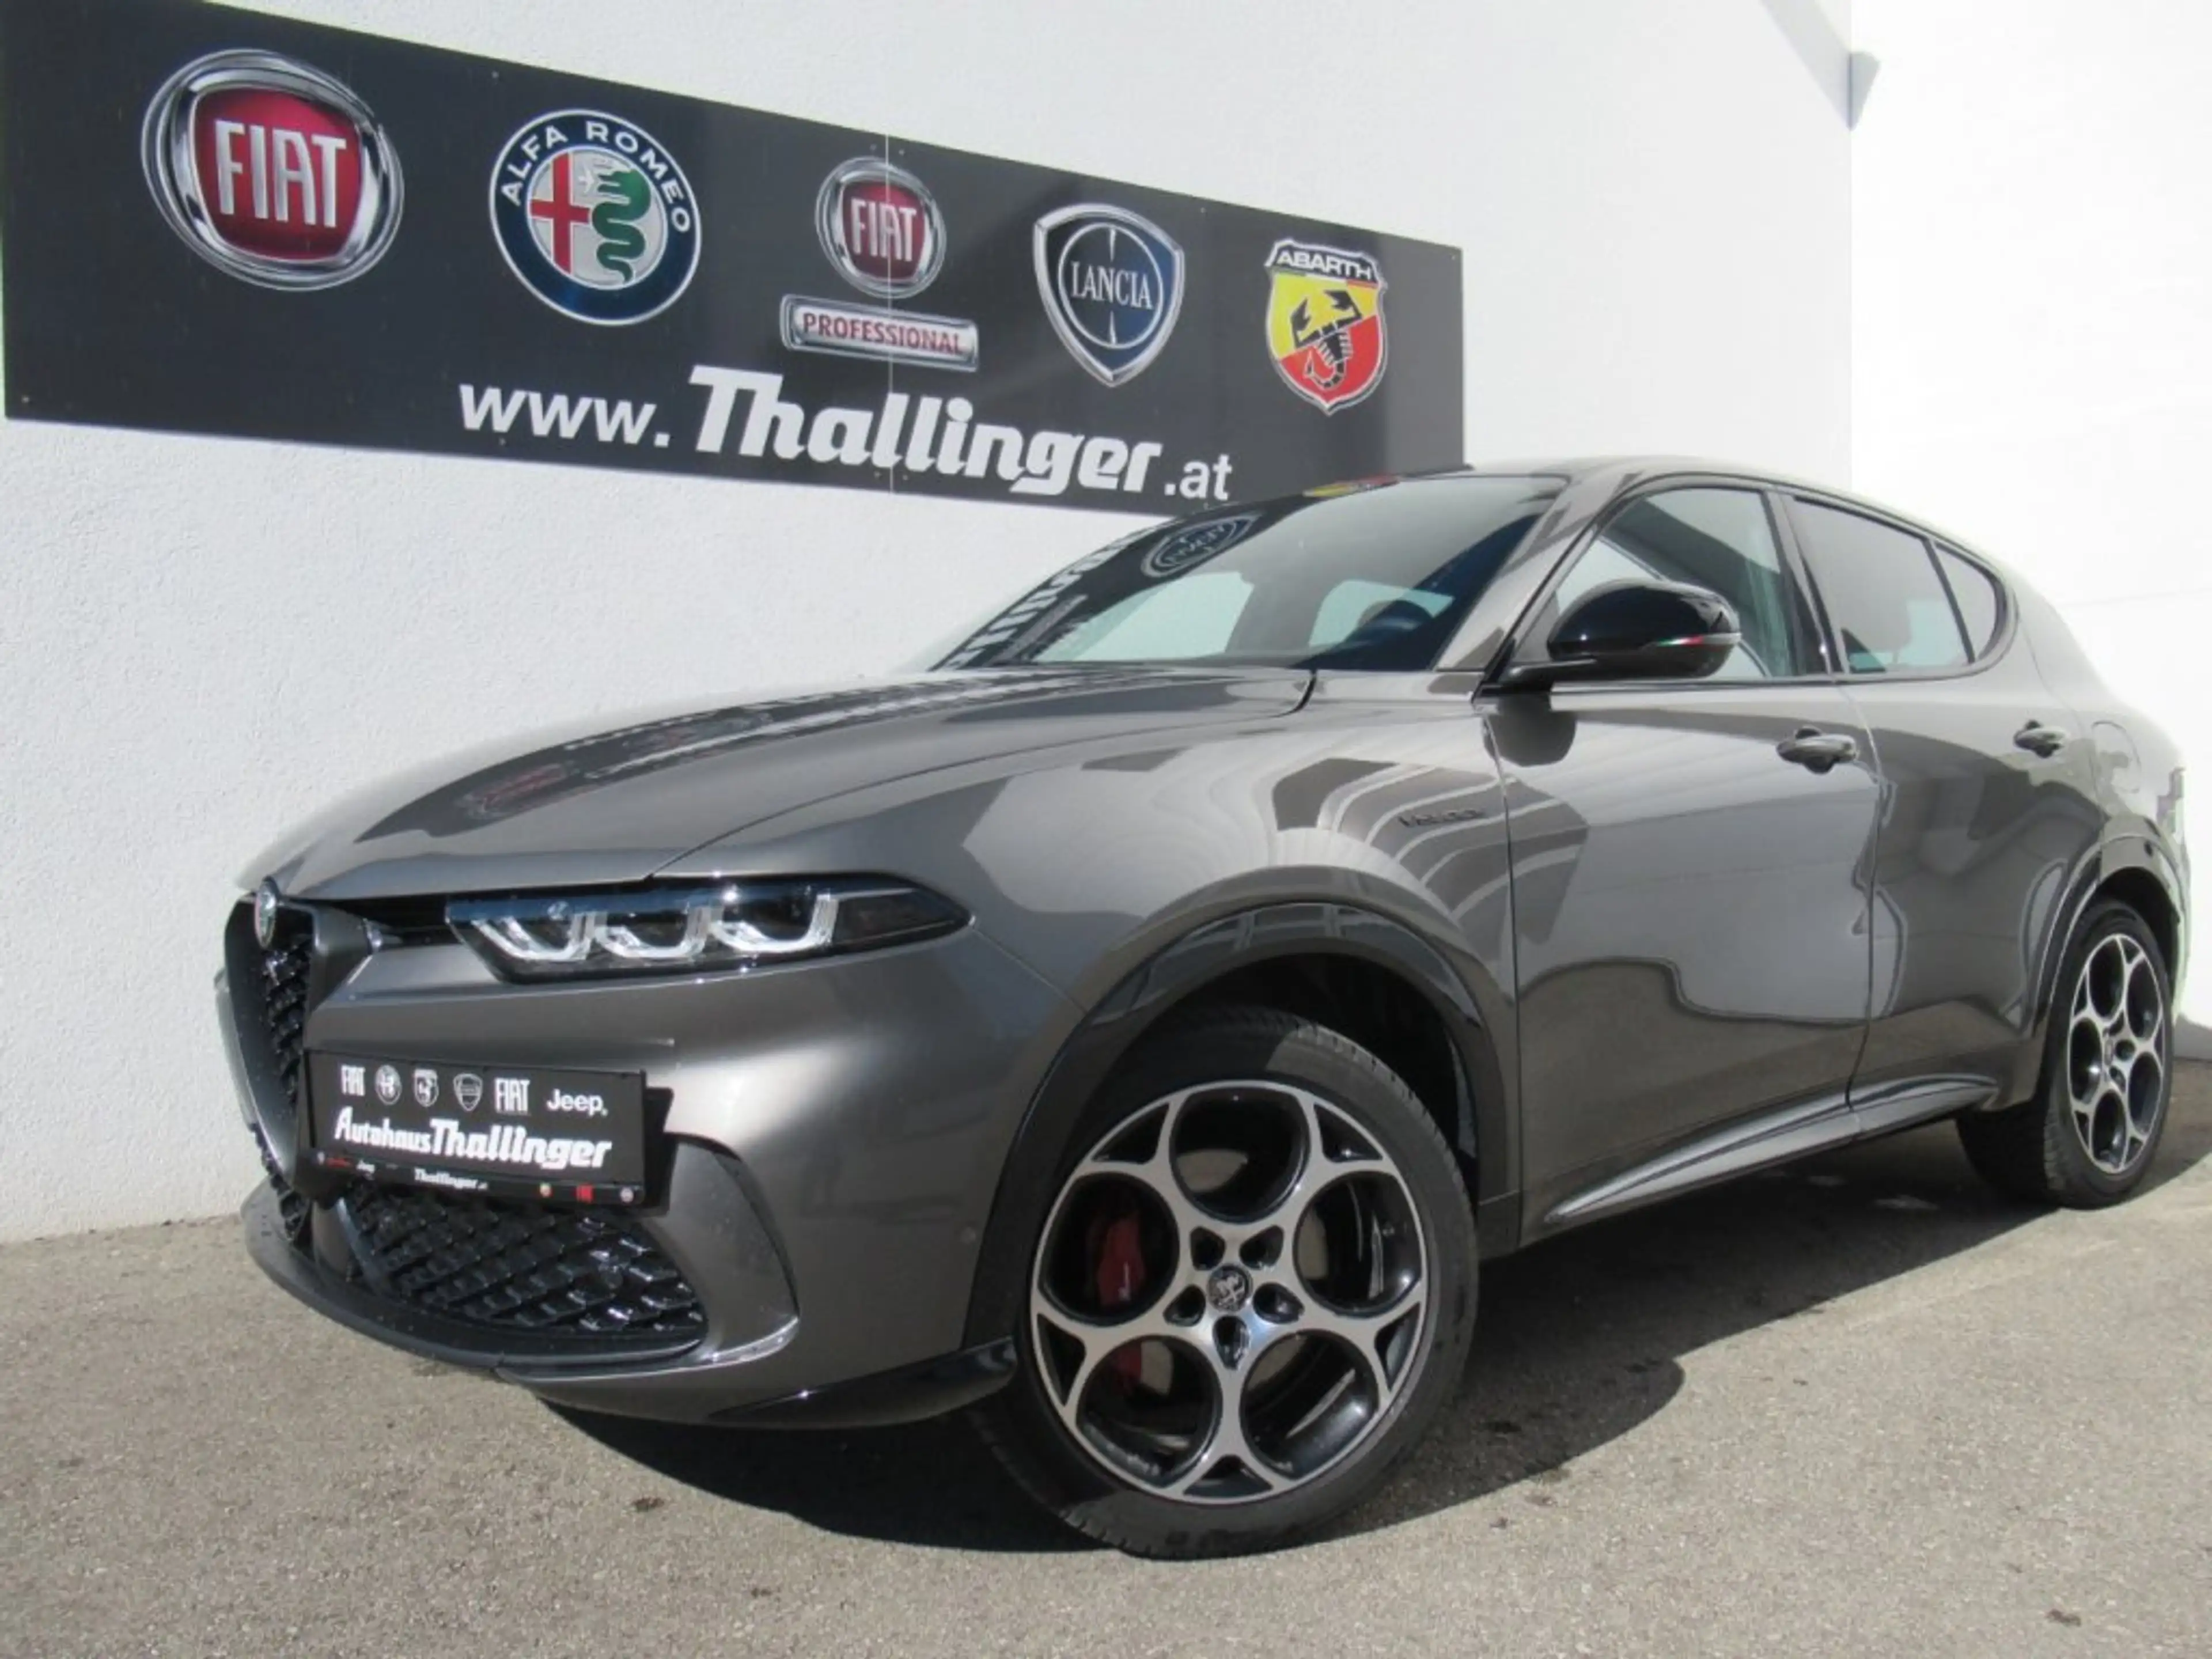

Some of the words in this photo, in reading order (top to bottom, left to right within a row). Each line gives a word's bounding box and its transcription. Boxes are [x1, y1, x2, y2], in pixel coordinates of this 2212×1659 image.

[215, 120, 346, 228] FIAT
[501, 124, 568, 206] ALFA
[586, 120, 691, 233] ROMEO
[850, 197, 917, 262] FIAT
[1071, 261, 1153, 310] LANCIA
[1277, 249, 1372, 280] ABARTH
[802, 313, 963, 355] PROFESSIONAL
[341, 1065, 365, 1096] FIAT
[495, 1078, 530, 1113] FIAT
